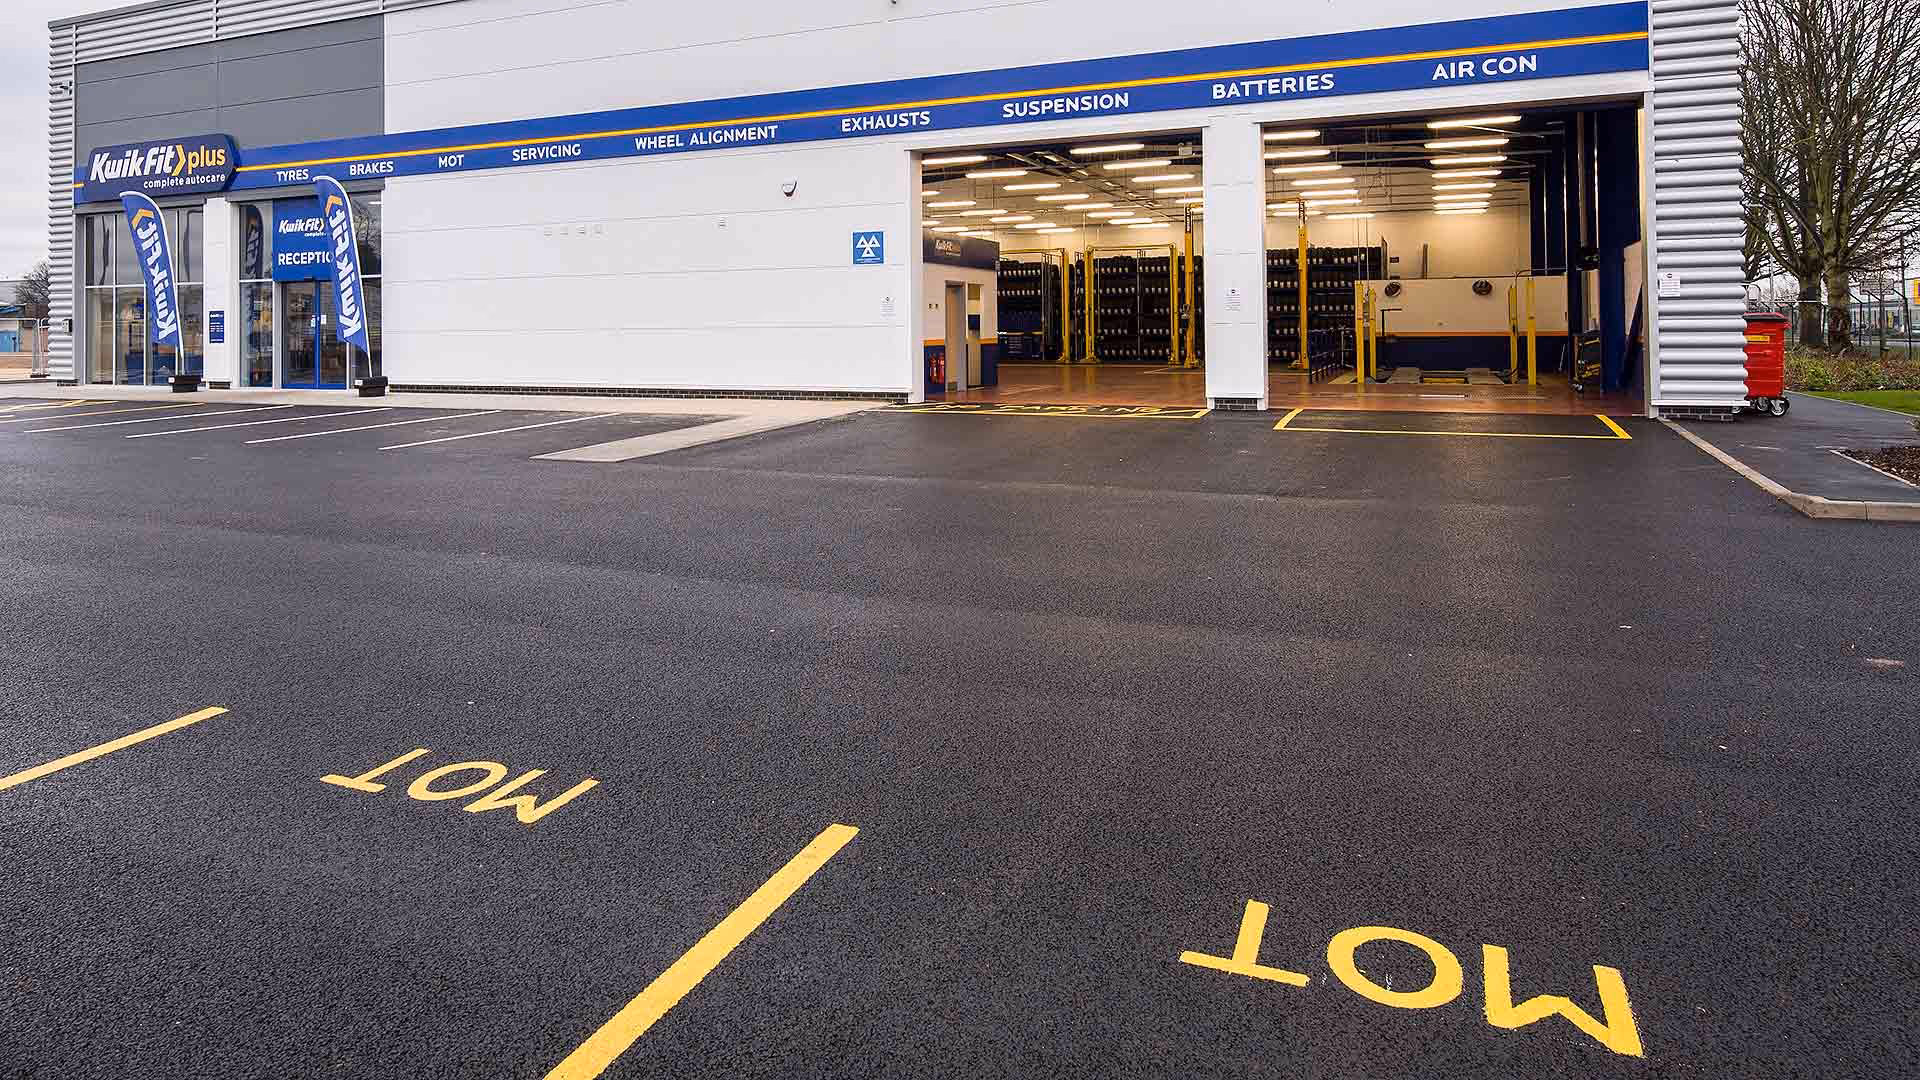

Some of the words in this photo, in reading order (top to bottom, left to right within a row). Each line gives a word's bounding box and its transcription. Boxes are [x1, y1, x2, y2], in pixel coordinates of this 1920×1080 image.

[1432, 58, 1475, 82] AIR
[1481, 54, 1538, 77] CON
[1211, 72, 1336, 100] BATTERIES
[1002, 91, 1130, 119] SUSPENSION
[840, 110, 932, 133] EXHAUSTS
[634, 133, 684, 151] WHEEL
[689, 124, 779, 147] ALIGNMENT
[187, 145, 226, 175] plus
[437, 153, 465, 169] MOT
[511, 143, 582, 163] SERVICING
[143, 177, 184, 189] complete
[185, 173, 226, 185] autocare
[276, 168, 310, 182] TYRES
[349, 160, 395, 177] BRAKES
[319, 748, 600, 824] MOT
[1179, 898, 1646, 1058] MOT
